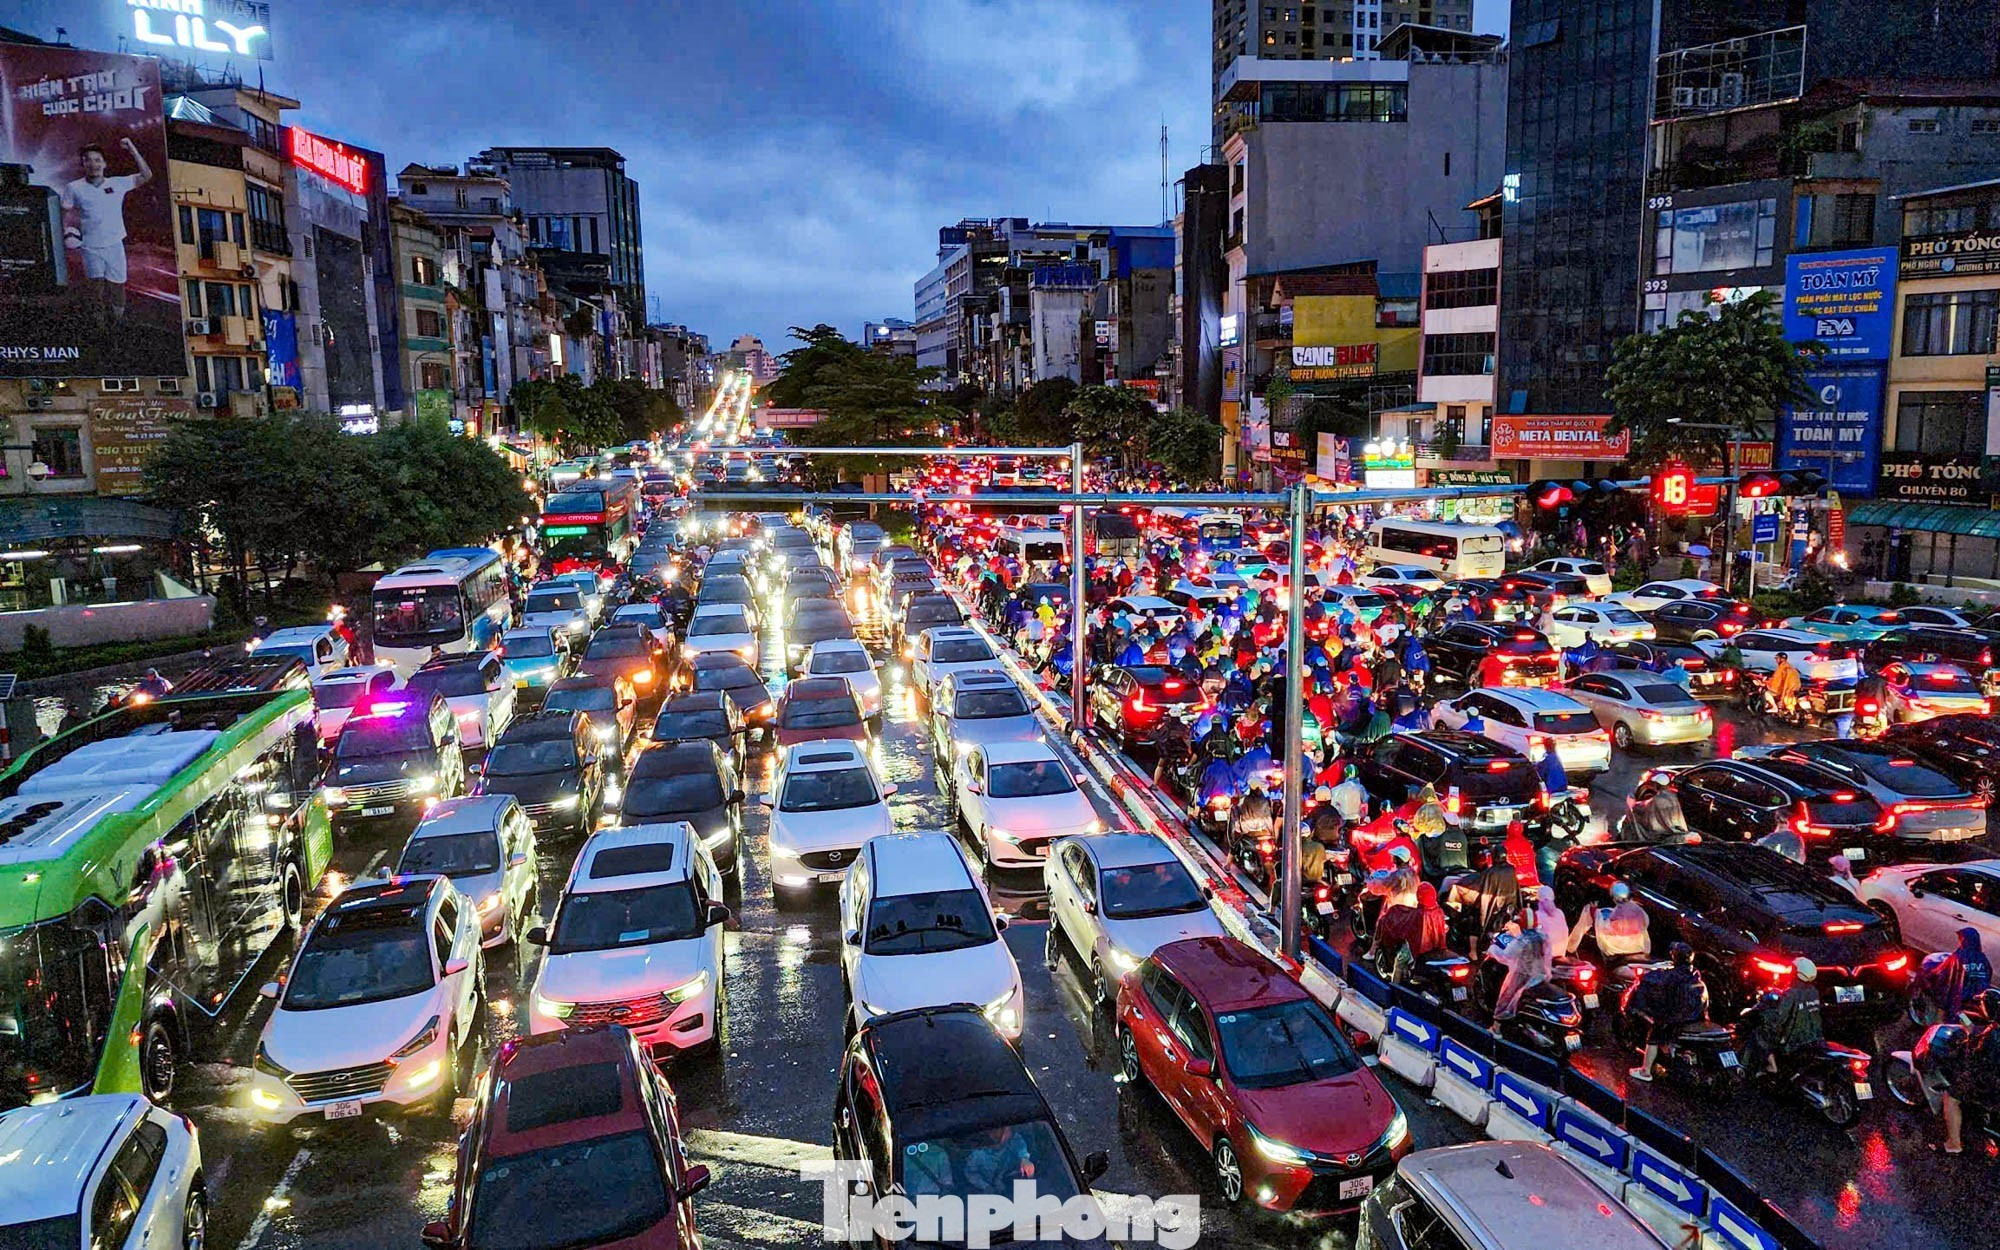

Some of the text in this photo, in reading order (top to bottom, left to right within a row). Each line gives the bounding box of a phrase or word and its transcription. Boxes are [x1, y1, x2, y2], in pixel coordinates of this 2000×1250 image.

[134, 9, 266, 55] LILY
[1649, 196, 1673, 209] 393
[1910, 237, 1949, 256] PHỞ
[1800, 266, 1879, 290] TOÀN MỸ
[1645, 280, 1668, 292] 393
[1816, 319, 1855, 336] FDA
[43, 346, 80, 358] MAN
[1519, 430, 1602, 442] META DENTAL
[1793, 424, 1865, 441] TOÀN MỸ
[1882, 460, 1923, 478] PHỞ
[1900, 484, 1968, 497] CHUYÊN BÒ
[1349, 1179, 1364, 1188] 30G
